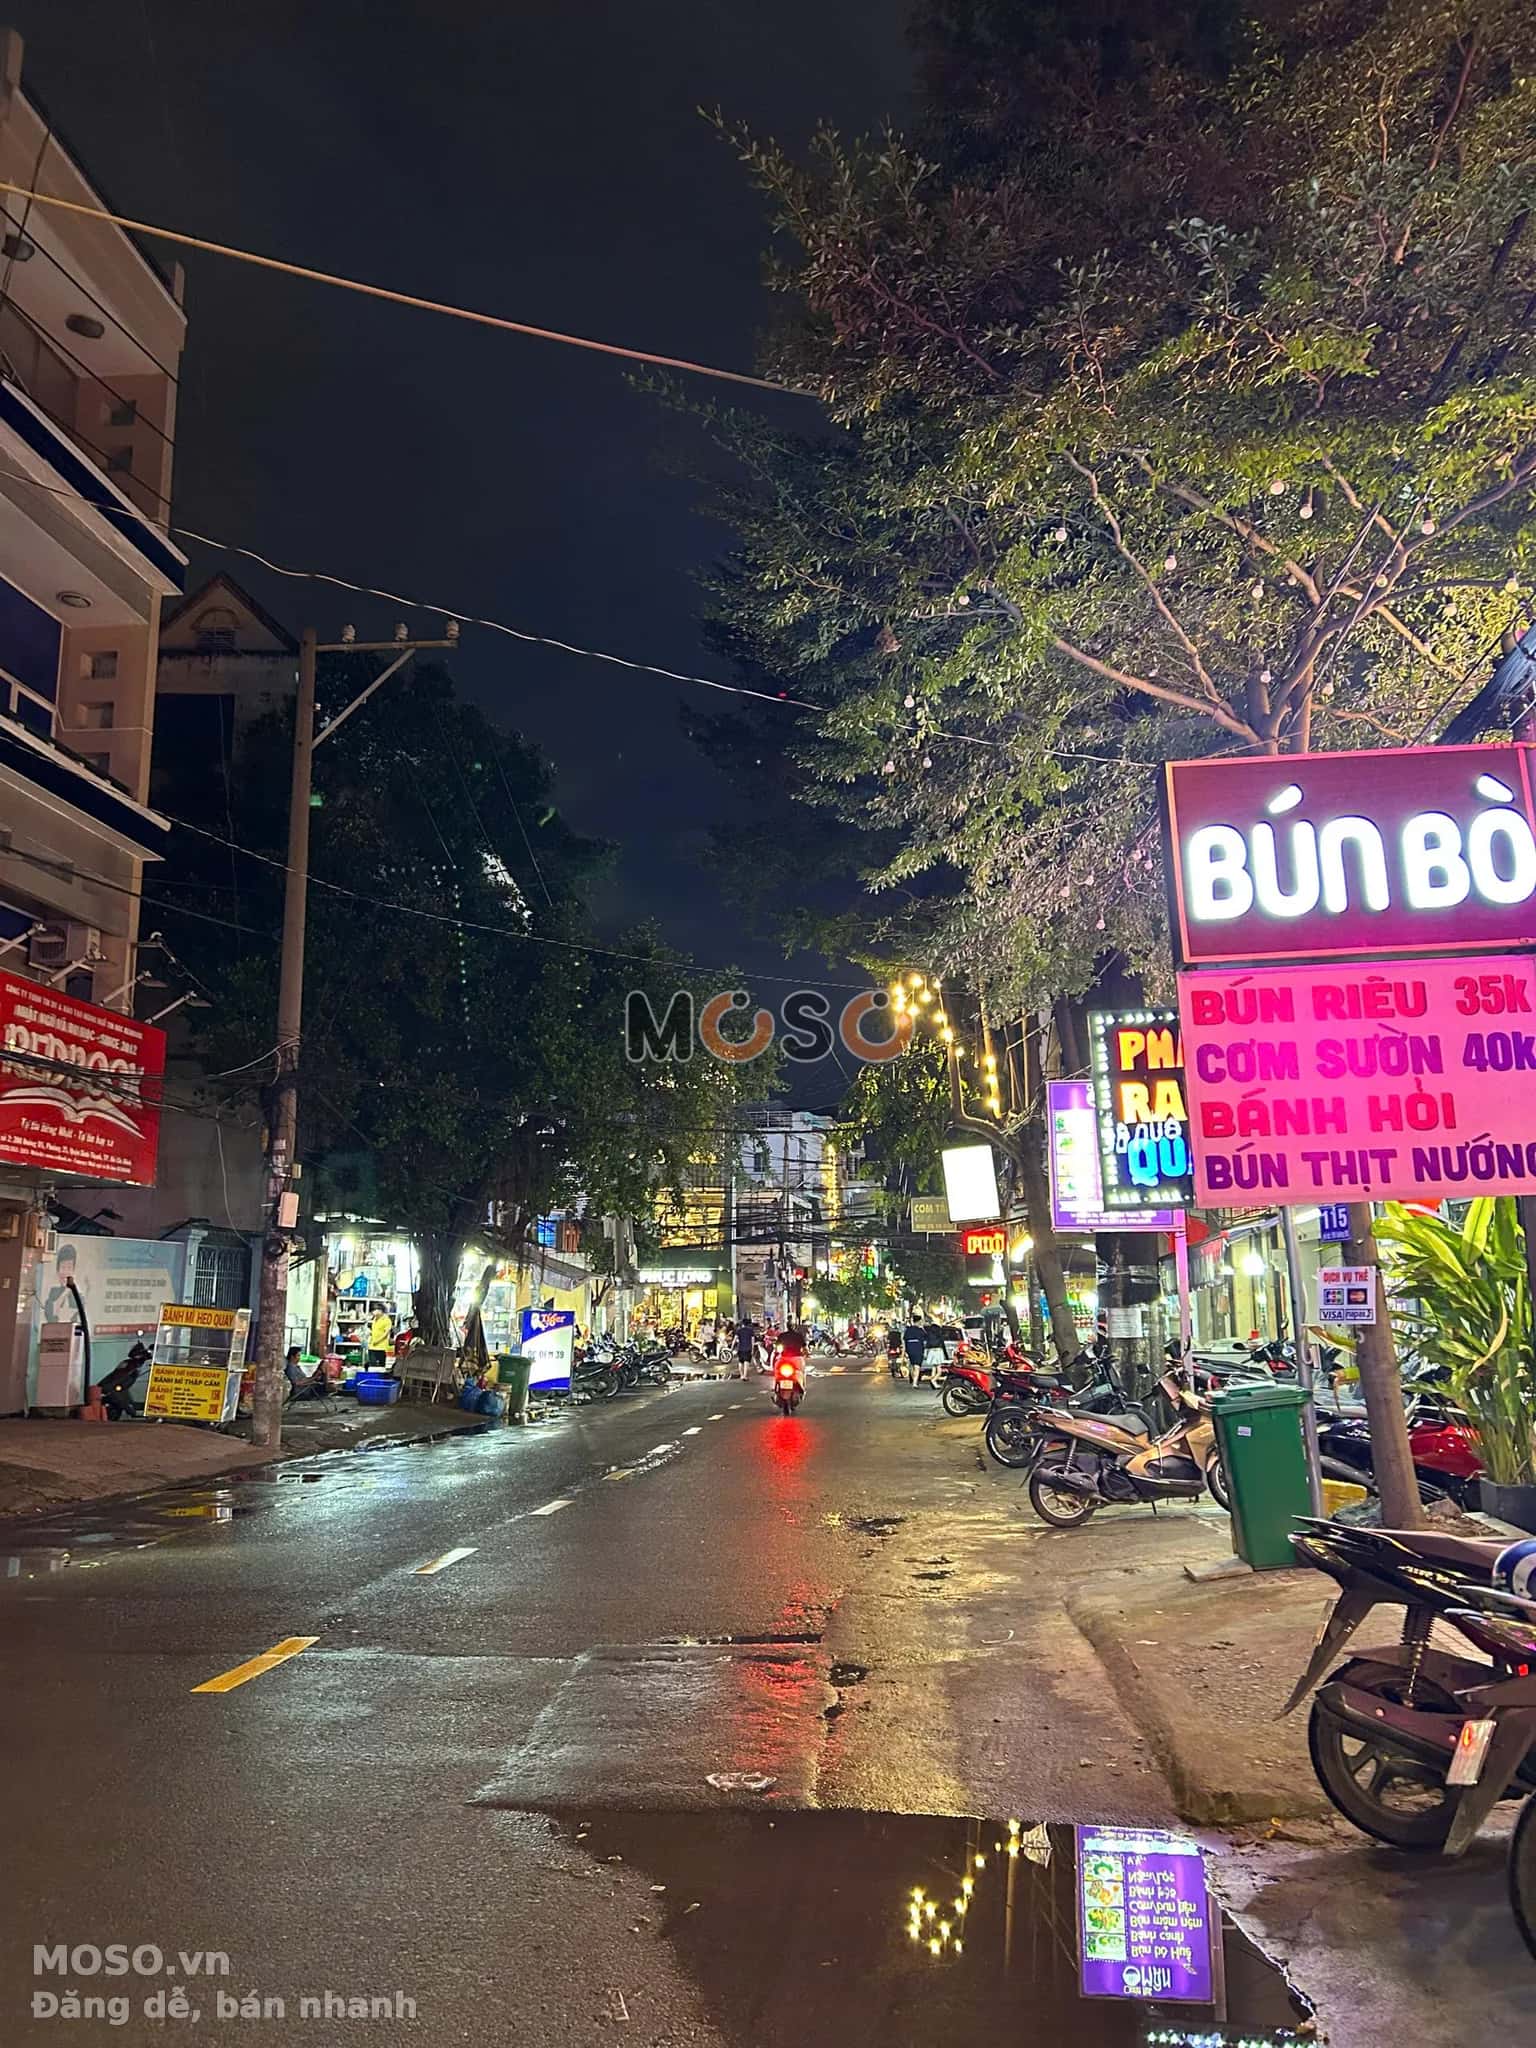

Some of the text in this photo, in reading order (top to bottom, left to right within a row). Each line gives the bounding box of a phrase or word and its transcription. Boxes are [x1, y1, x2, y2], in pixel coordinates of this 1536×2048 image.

[1188, 772, 1536, 920] BÚN BÒ
[1191, 974, 1533, 1025] BÚN RIÊU 35k
[1196, 1038, 1300, 1083] CƠM
[1315, 1023, 1444, 1079] SƯỜN
[1200, 1087, 1347, 1138] BÁNH
[1205, 1142, 1289, 1190] BÚN
[1301, 1148, 1398, 1192] THỊT
[1321, 1206, 1348, 1230] 115
